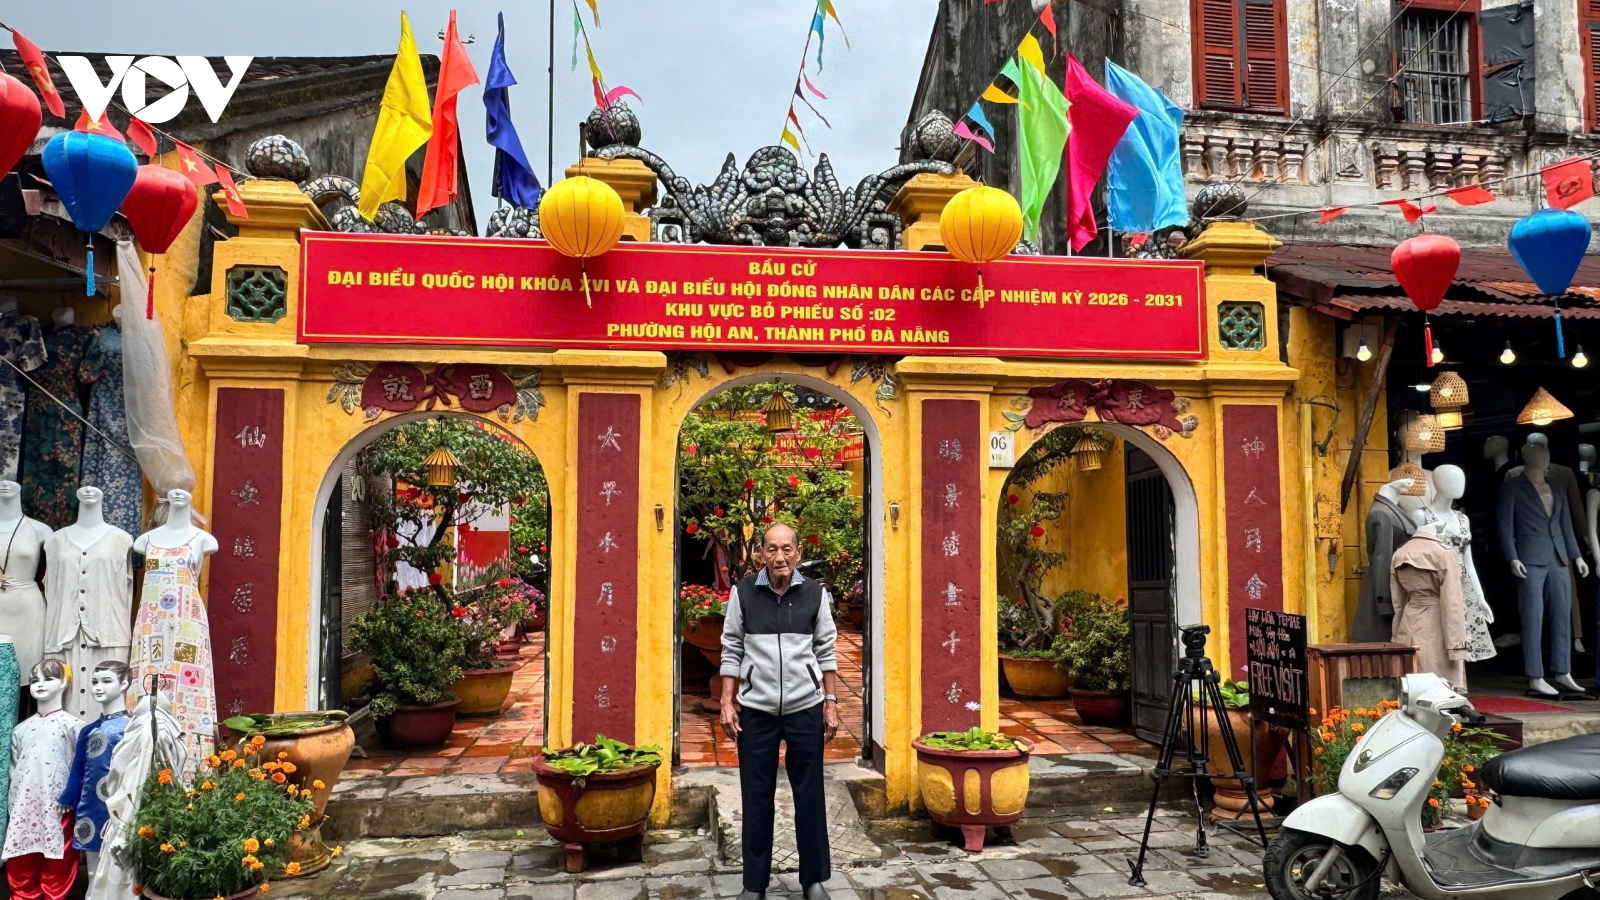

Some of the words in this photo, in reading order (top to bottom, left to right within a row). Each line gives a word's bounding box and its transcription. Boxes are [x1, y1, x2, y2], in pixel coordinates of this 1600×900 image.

[749, 258, 785, 276] BẦU
[791, 260, 817, 277] CỬ
[327, 270, 362, 288] ĐẠI
[369, 267, 415, 287] BIỂU
[422, 270, 475, 289] QUỐC
[482, 273, 514, 292] HỘI
[520, 275, 573, 291] KHÓA
[579, 278, 610, 293] XVI
[615, 277, 640, 293] VÀ
[645, 281, 677, 298] ĐẠI
[683, 277, 725, 296] BIỂU
[731, 281, 762, 299] HỘI
[767, 280, 817, 298] ĐỒNG
[823, 284, 873, 300] NHÂN
[879, 285, 915, 301] DÂN
[920, 286, 956, 302] CÁC
[1001, 288, 1057, 306] NHIỆM
[1061, 289, 1083, 306] KỲ
[1088, 293, 1129, 306] 2026
[1144, 294, 1183, 307] 2031
[666, 303, 703, 317] KHU
[709, 303, 745, 320] VỰC
[750, 302, 775, 319] BỎ
[781, 303, 834, 320] PHIẾU
[840, 303, 864, 320] SỐ
[868, 308, 896, 321] :02
[607, 323, 685, 338] PHƯỜNG
[690, 323, 722, 342] HỘI
[727, 327, 759, 341] AN,
[764, 323, 825, 341] THÀNH
[830, 324, 866, 341] PHỐ
[871, 325, 895, 342] ĐÀ
[900, 326, 950, 343] NẴNG
[991, 436, 1007, 450] 06
[1251, 661, 1274, 698] FREE
